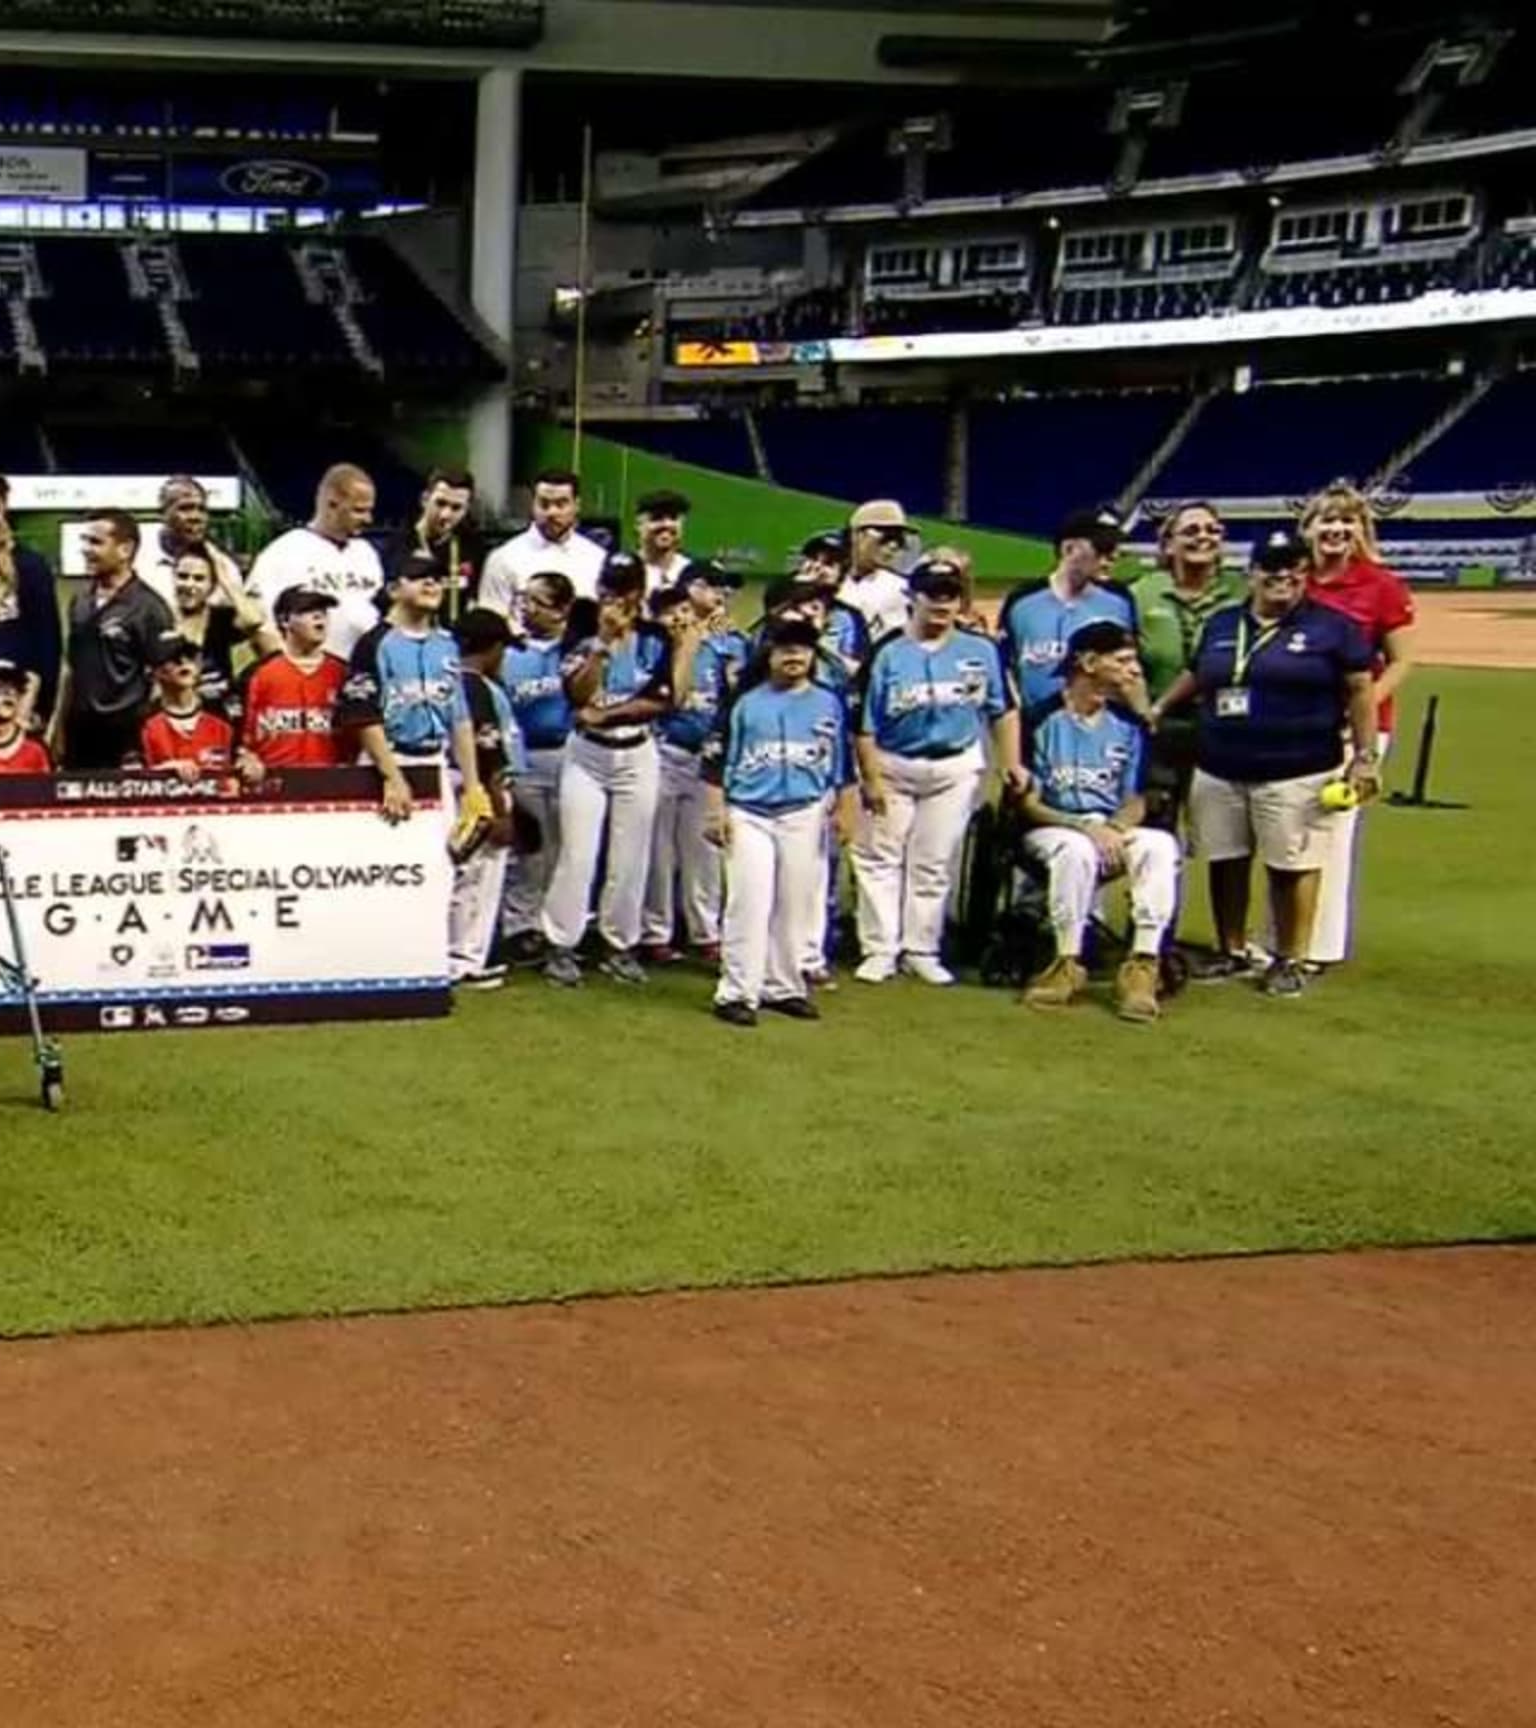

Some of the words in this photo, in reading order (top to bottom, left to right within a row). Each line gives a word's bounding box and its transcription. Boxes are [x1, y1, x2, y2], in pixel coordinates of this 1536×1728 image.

[51, 871, 165, 897] LEAGUE
[178, 867, 287, 893] SPECIAL
[290, 863, 425, 889] OLYMPICS
